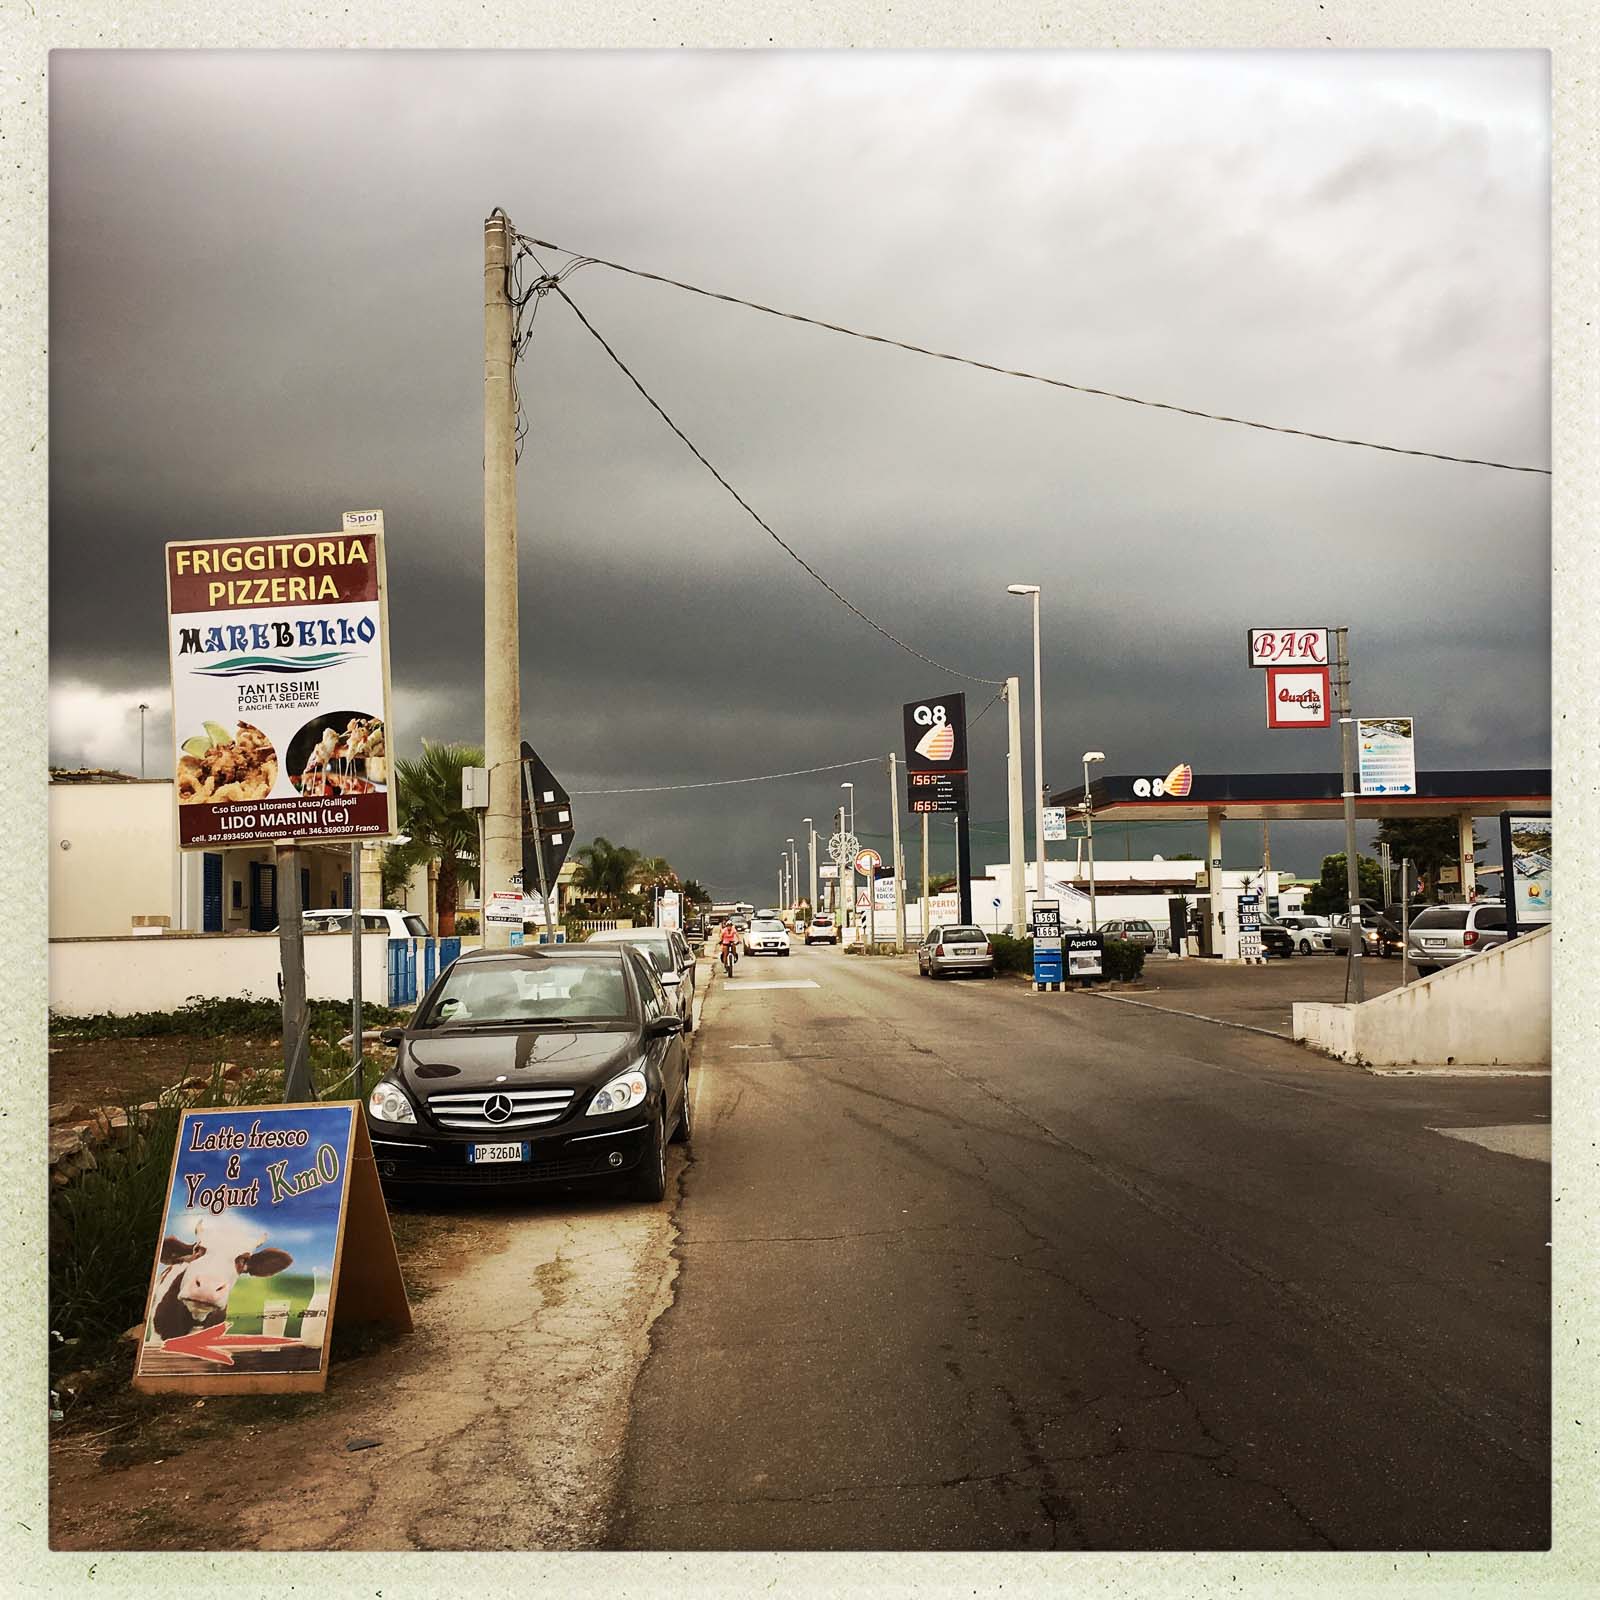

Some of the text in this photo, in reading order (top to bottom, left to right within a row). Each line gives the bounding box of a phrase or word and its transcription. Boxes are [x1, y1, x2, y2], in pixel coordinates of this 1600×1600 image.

[176, 540, 369, 575] FRIGGITORIA
[208, 575, 340, 606] PIZZERIA
[178, 616, 376, 656] MAREBELLO
[1254, 632, 1326, 662] BAR
[238, 681, 319, 695] TANTISSIMI
[238, 692, 320, 704] POSTI A SEDERE
[914, 706, 946, 726] Q8
[913, 775, 937, 785] 1569
[1133, 778, 1164, 797] Q8
[212, 798, 357, 814] C.so Europa Litoranea Leuca/Gallipoli
[914, 801, 938, 811] 1669
[220, 809, 349, 830] LIDO MARINI (Le)
[192, 835, 206, 843] cell.
[208, 832, 254, 842] 347.8934500
[255, 830, 287, 839] Vincenzo
[293, 828, 308, 836] cell.
[309, 825, 354, 835] 346.3690307
[356, 824, 380, 832] Franco
[1071, 940, 1097, 948] Aperto
[190, 1120, 308, 1152] Latte fresco
[227, 1155, 240, 1179] &
[184, 1174, 259, 1215] Yogurt
